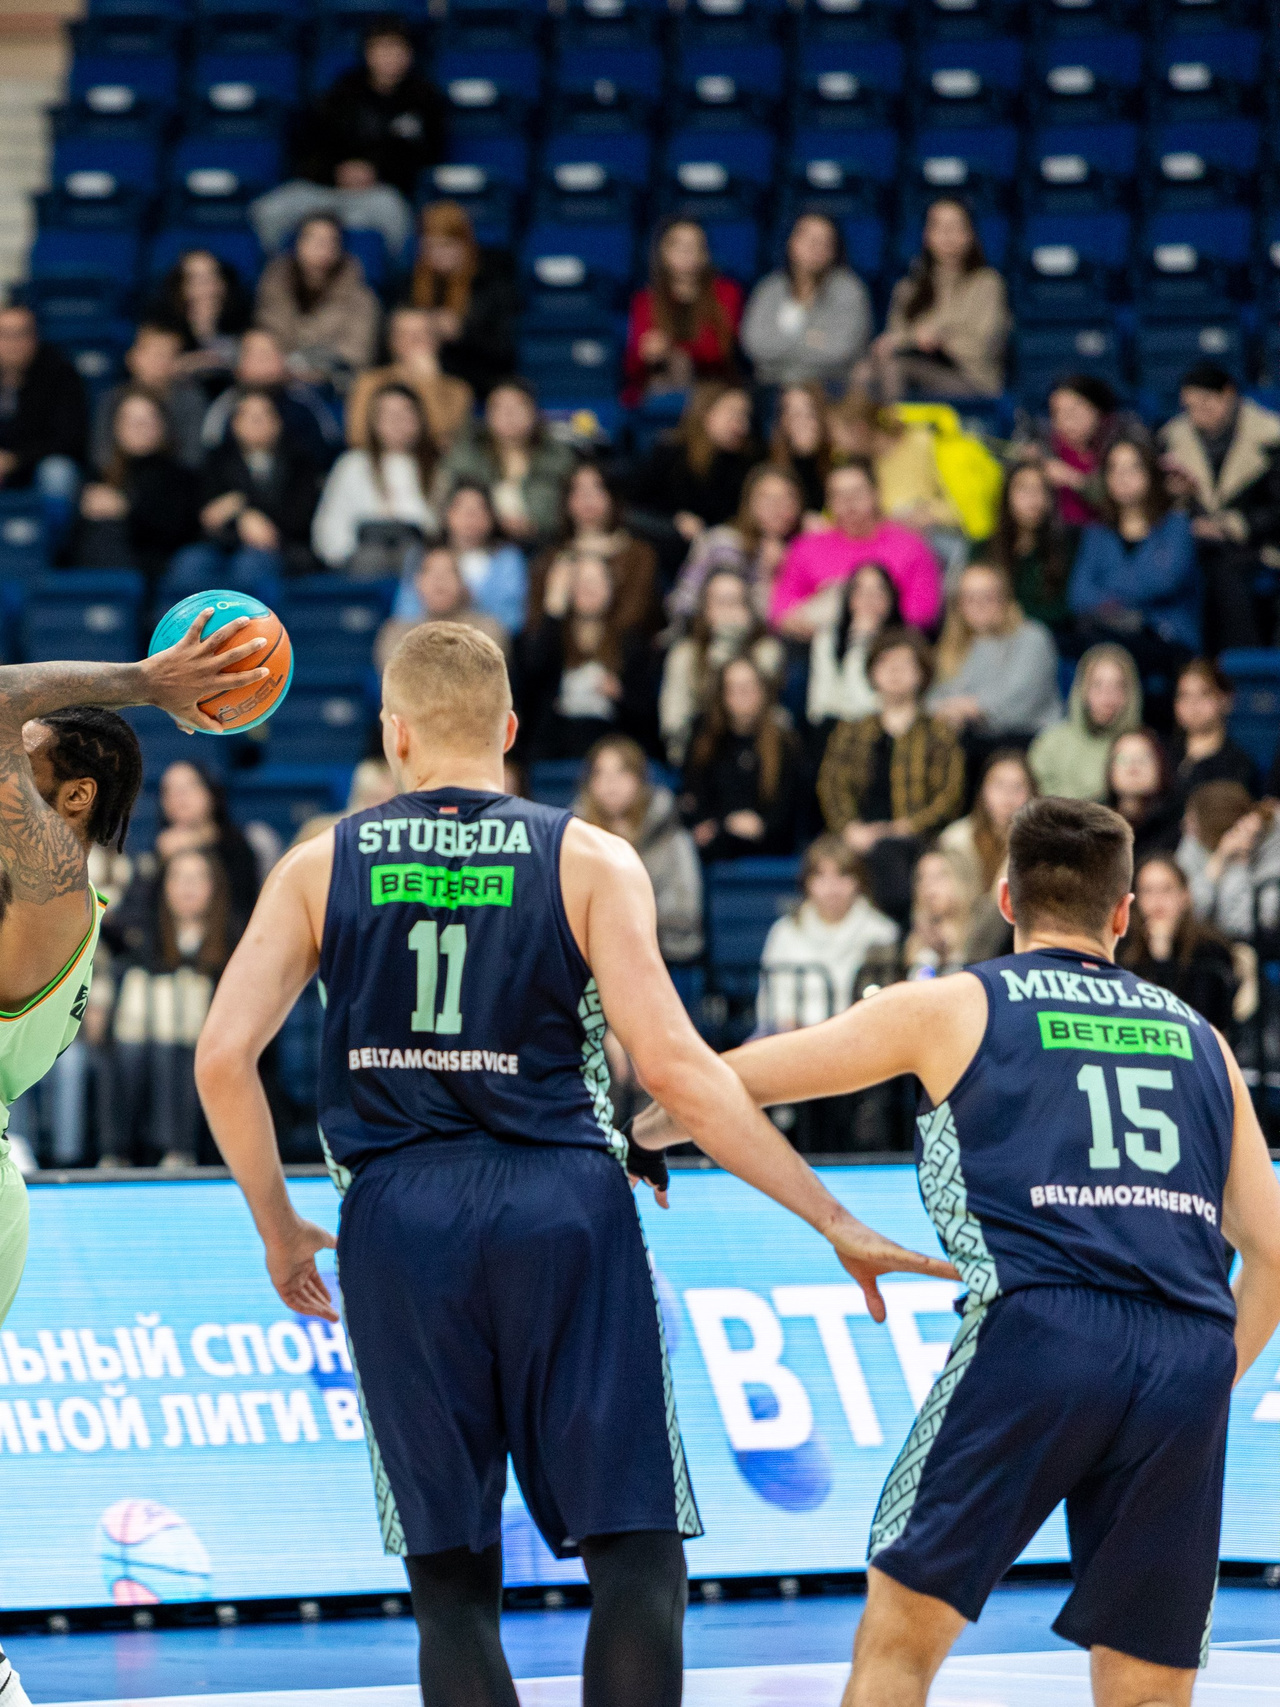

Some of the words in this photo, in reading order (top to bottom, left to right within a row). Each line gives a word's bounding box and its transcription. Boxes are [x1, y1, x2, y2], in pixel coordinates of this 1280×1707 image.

[408, 920, 467, 1035] 11
[1076, 1064, 1181, 1175] 15
[192, 1321, 353, 1377] СПОН
[161, 1390, 320, 1448] ЛИГИ
[324, 1388, 366, 1442] В
